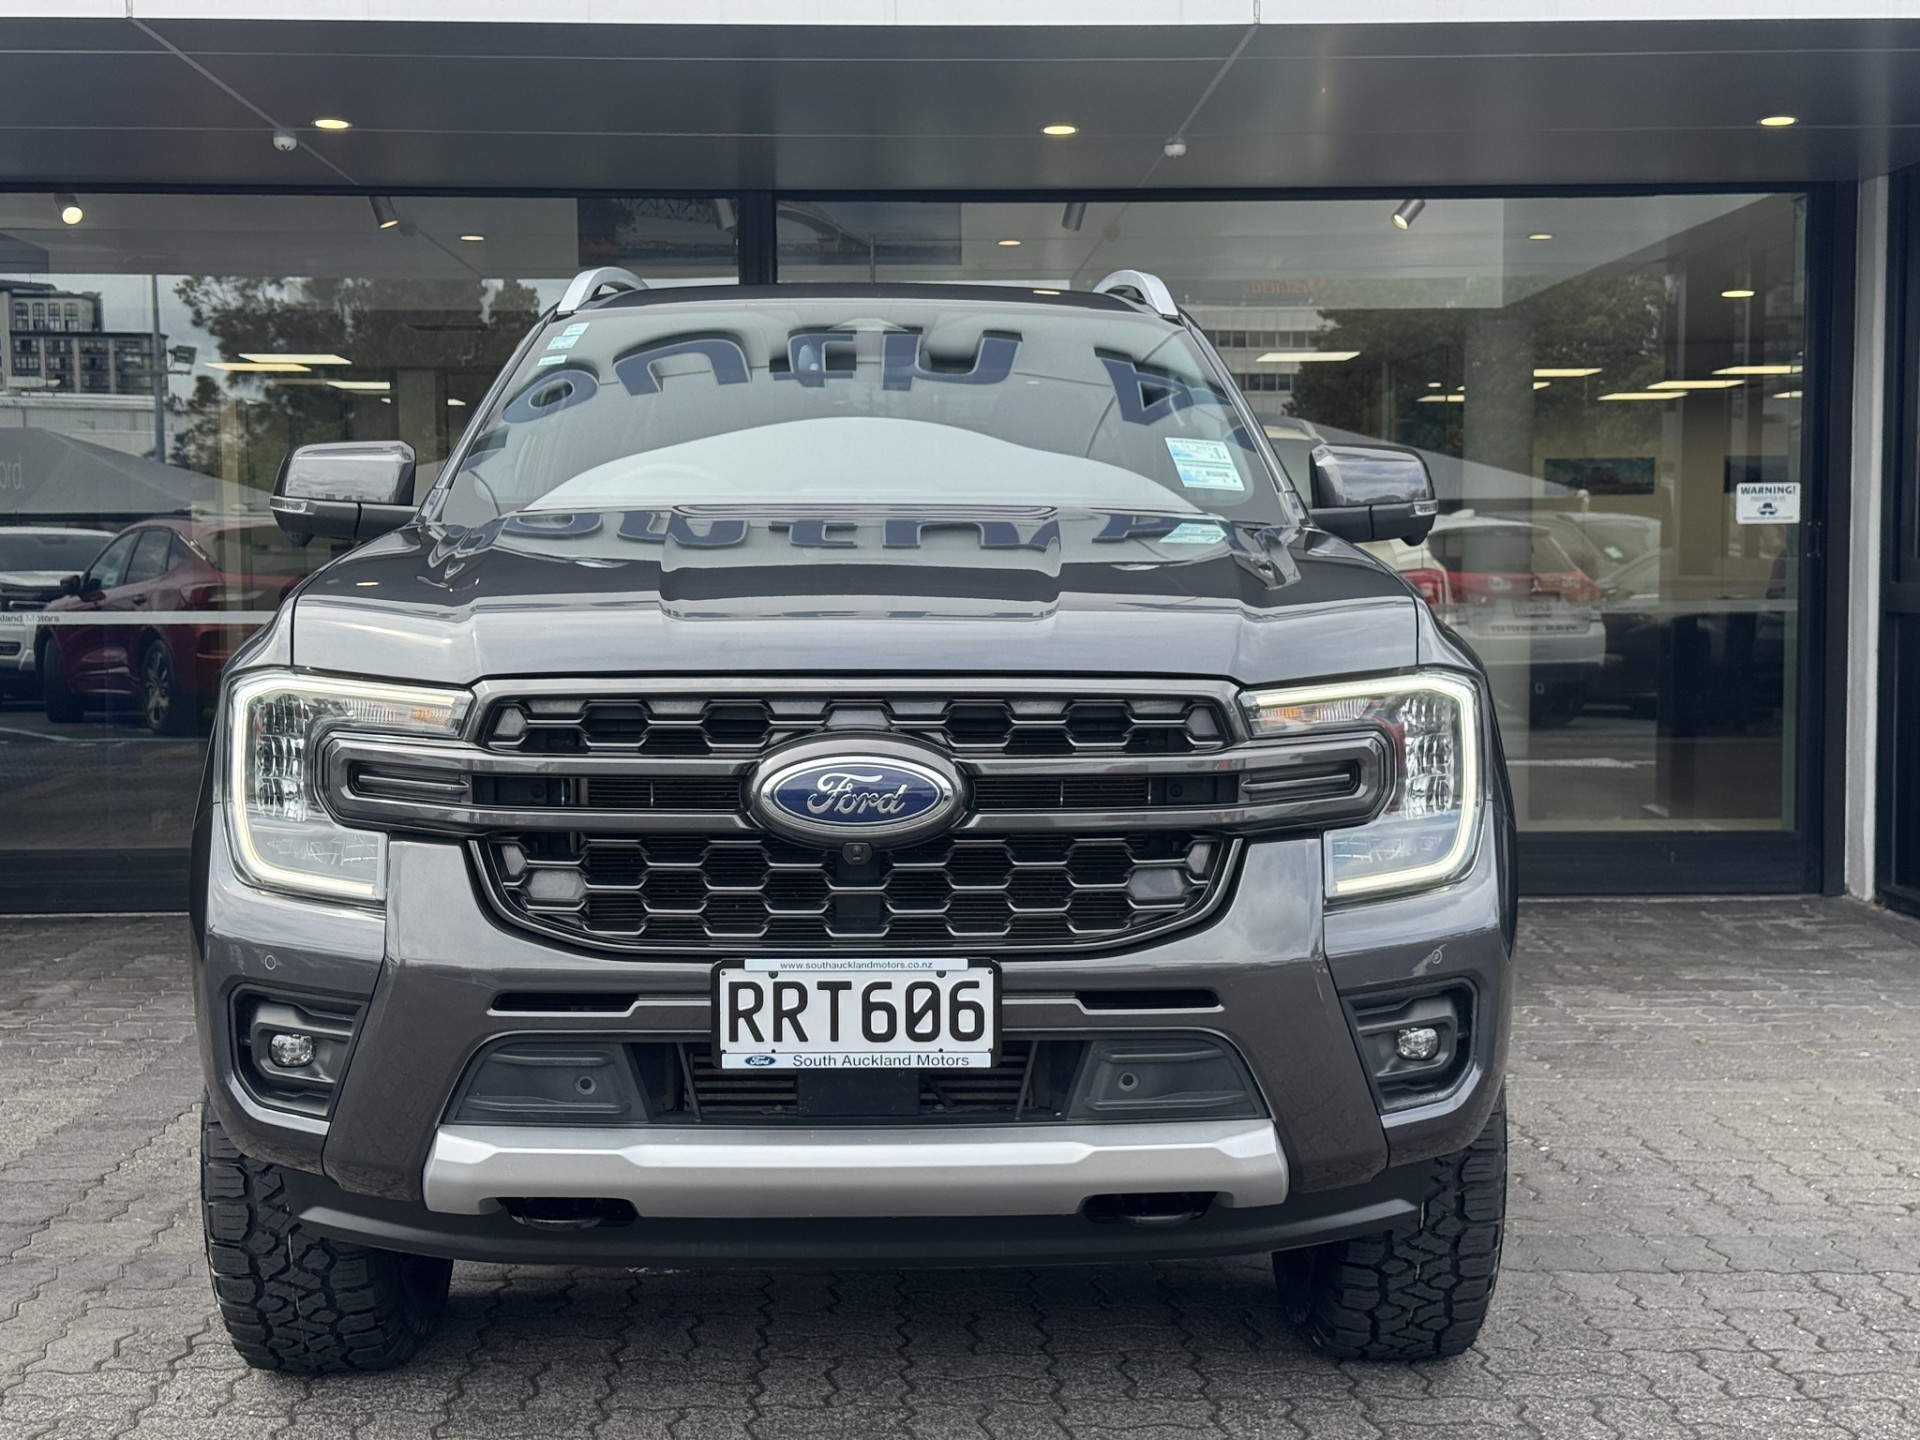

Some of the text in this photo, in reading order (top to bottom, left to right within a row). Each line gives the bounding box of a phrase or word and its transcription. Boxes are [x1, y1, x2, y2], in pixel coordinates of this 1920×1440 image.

[1741, 486, 1796, 495] WARNING!
[25, 614, 60, 622] Motors
[807, 773, 908, 814] Ford
[780, 961, 933, 970] www.southaucklandmotors.co.nz
[728, 981, 985, 1043] RRT606
[793, 1055, 970, 1067] South Auckland Motors
